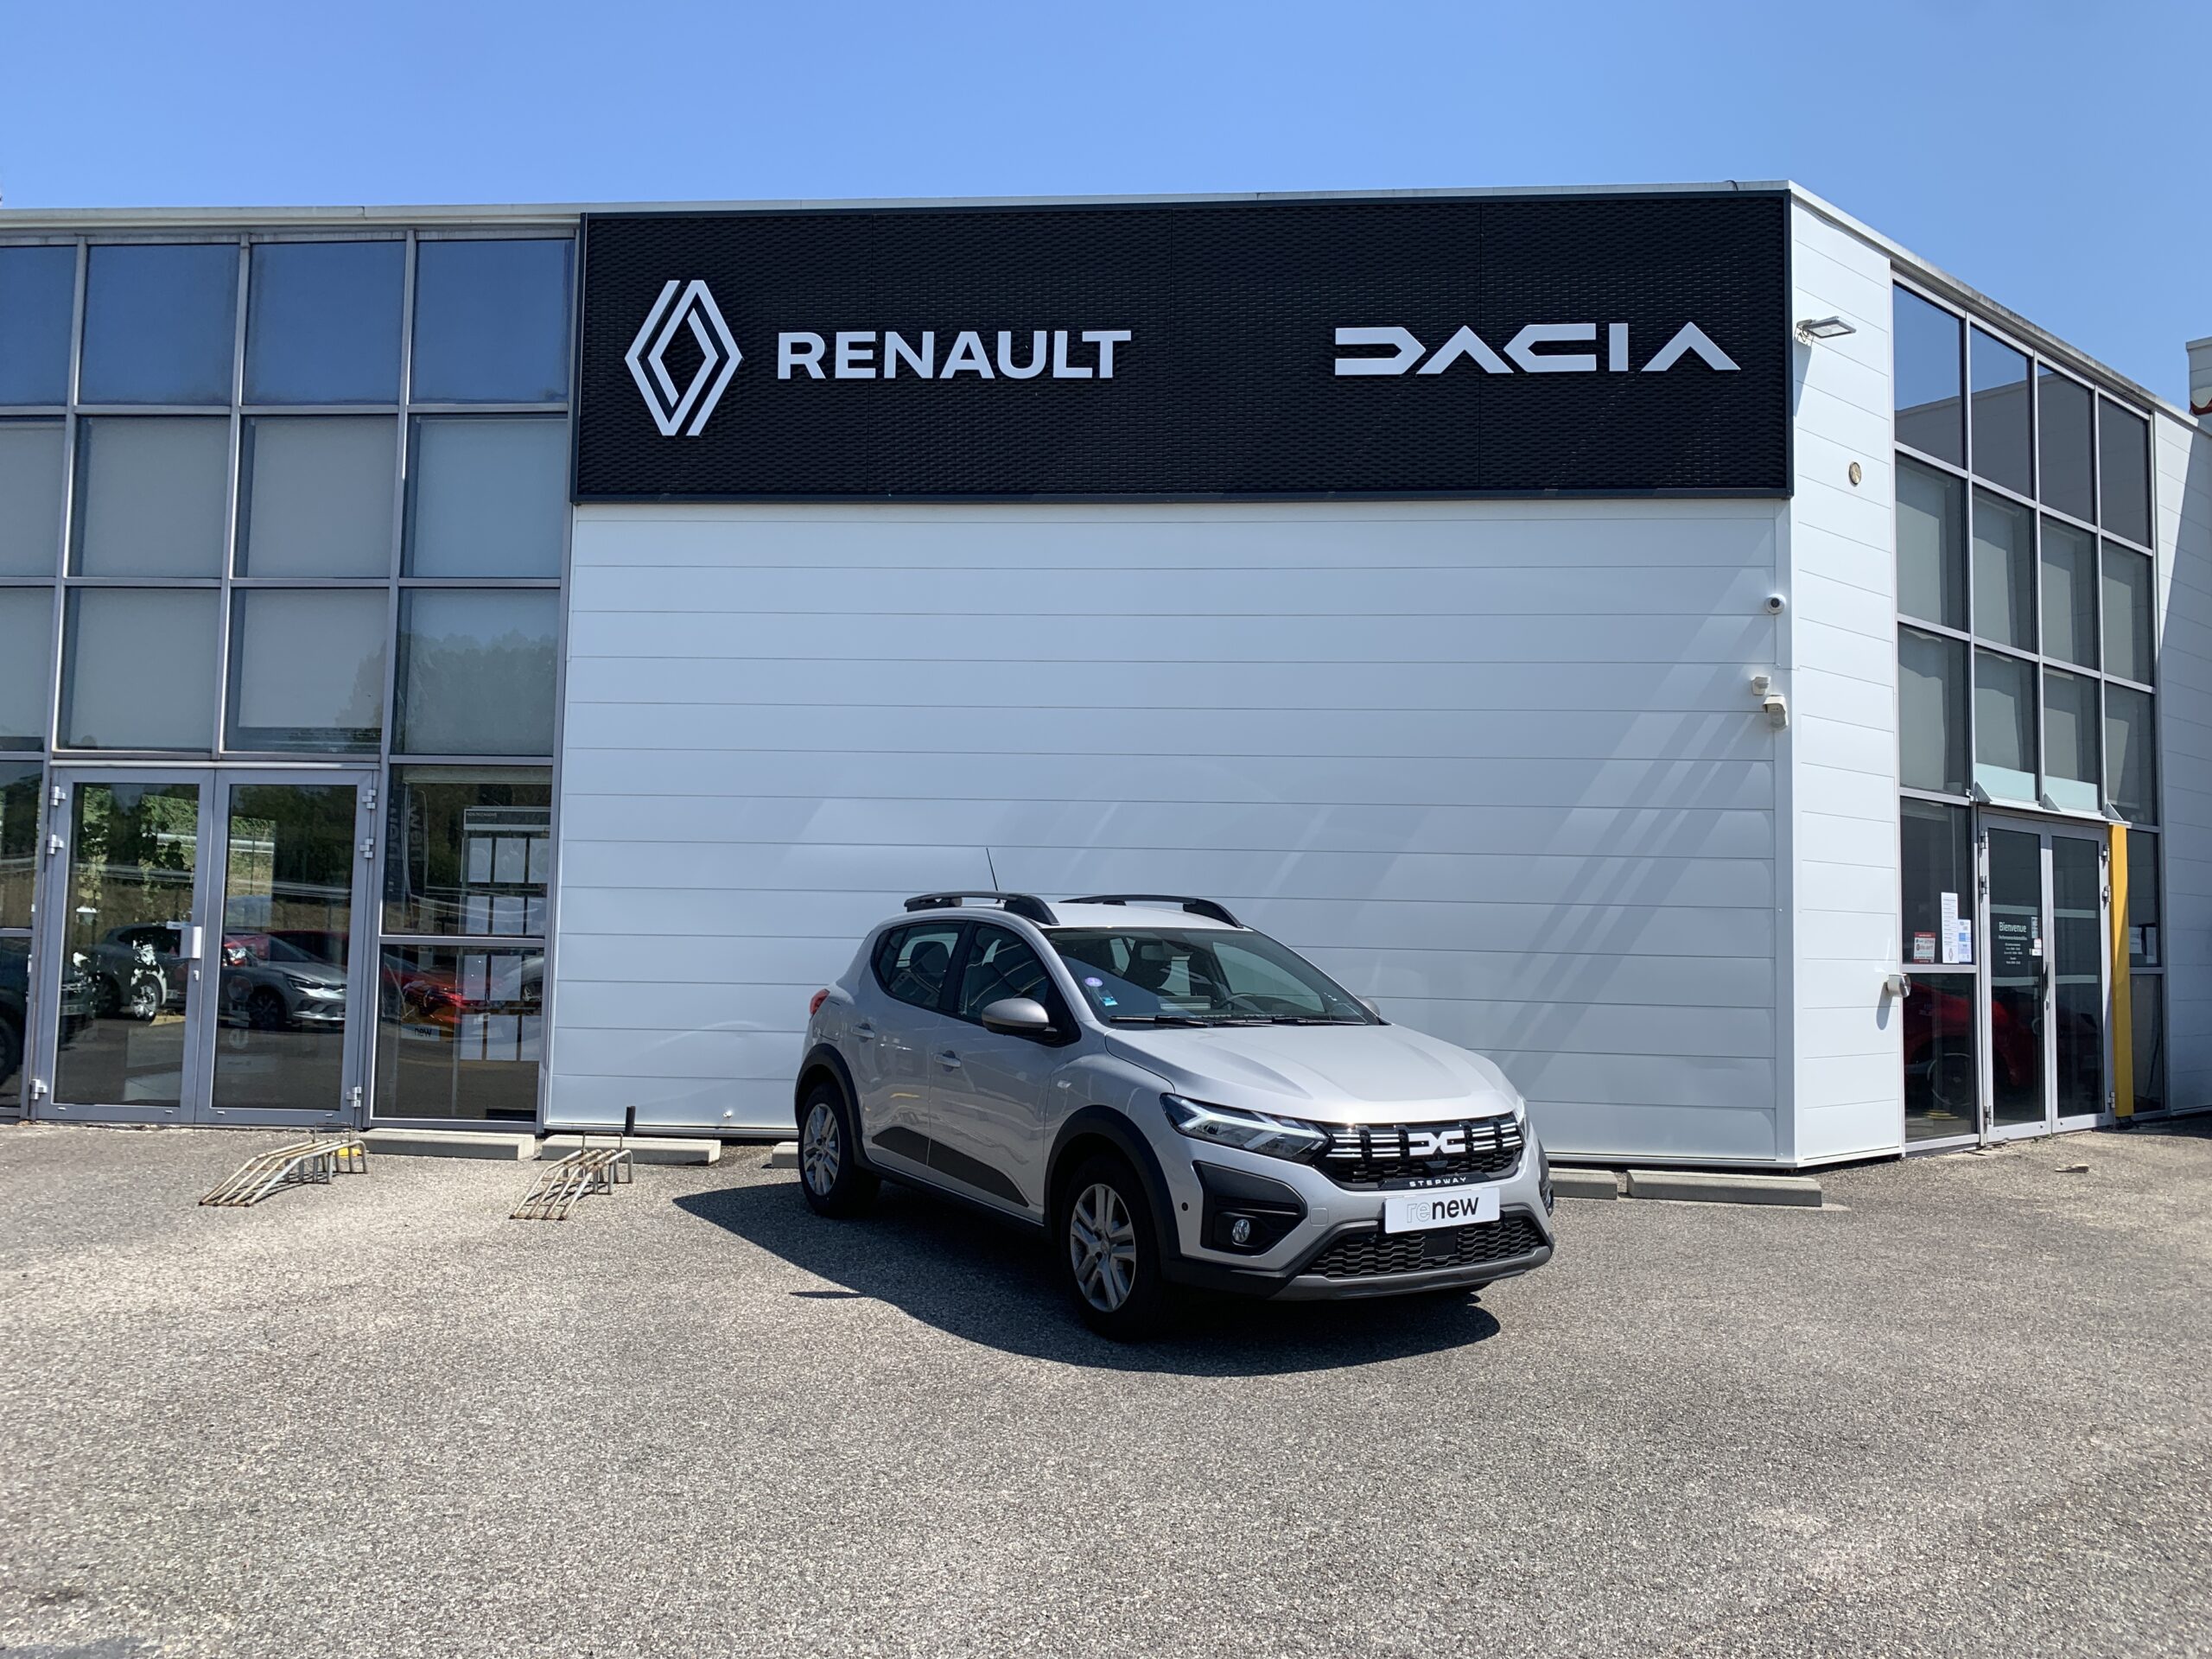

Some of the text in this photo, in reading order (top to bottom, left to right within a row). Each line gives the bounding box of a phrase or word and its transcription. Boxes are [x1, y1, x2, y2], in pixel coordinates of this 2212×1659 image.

[778, 330, 1132, 379] RENAULT
[1335, 321, 1741, 376] DACIA
[1999, 921, 2027, 933] Bienvenue
[1409, 1177, 1467, 1187] STEPWAY
[1407, 1197, 1479, 1223] renew
